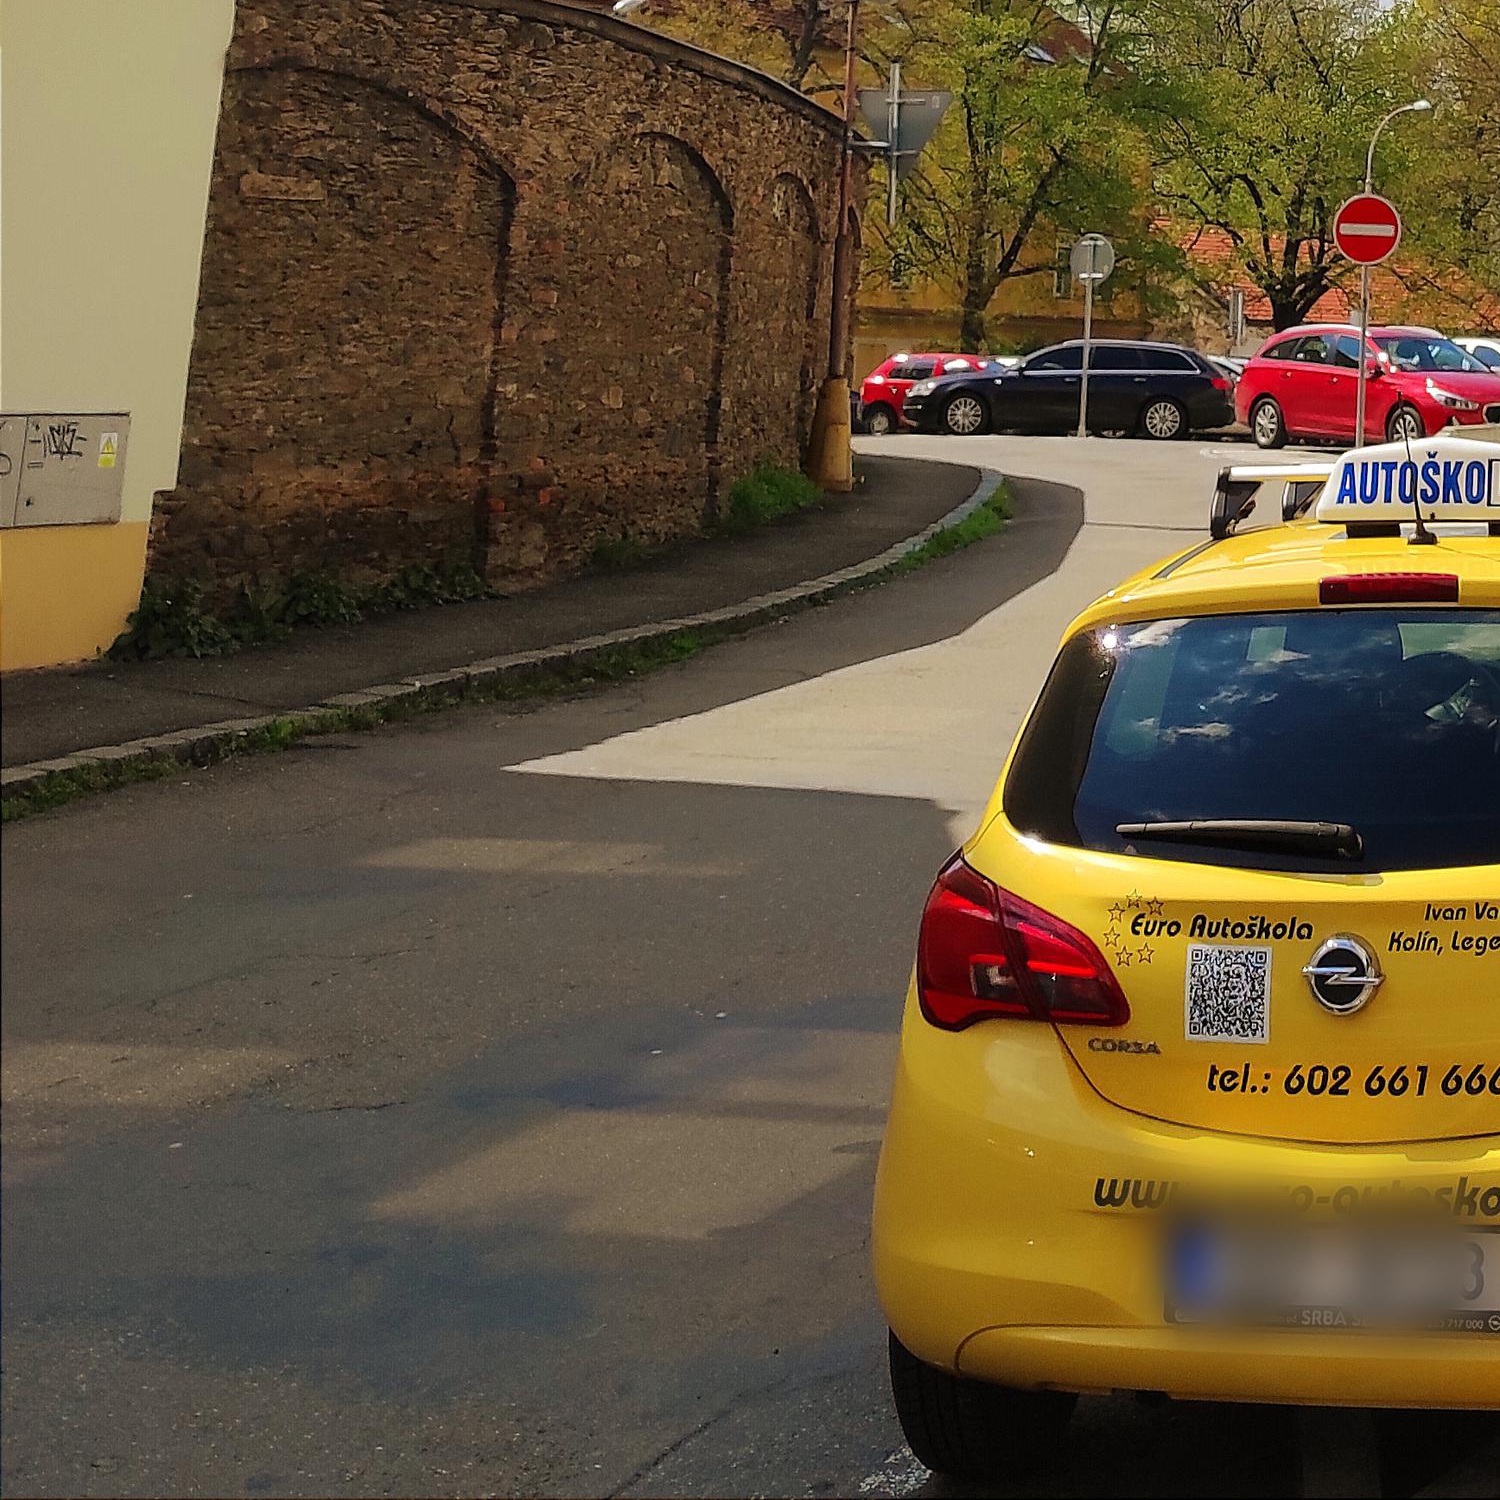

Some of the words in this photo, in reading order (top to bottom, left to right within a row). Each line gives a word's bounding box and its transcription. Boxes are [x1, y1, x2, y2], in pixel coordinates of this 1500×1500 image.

[1424, 903, 1467, 921] Ivan
[1131, 913, 1182, 938] Euro
[1190, 914, 1314, 940] Autoškola
[1388, 931, 1444, 956] Kolín,
[1207, 1062, 1271, 1094] tel.:
[1284, 1065, 1351, 1096] 602
[1364, 1064, 1429, 1096] 661
